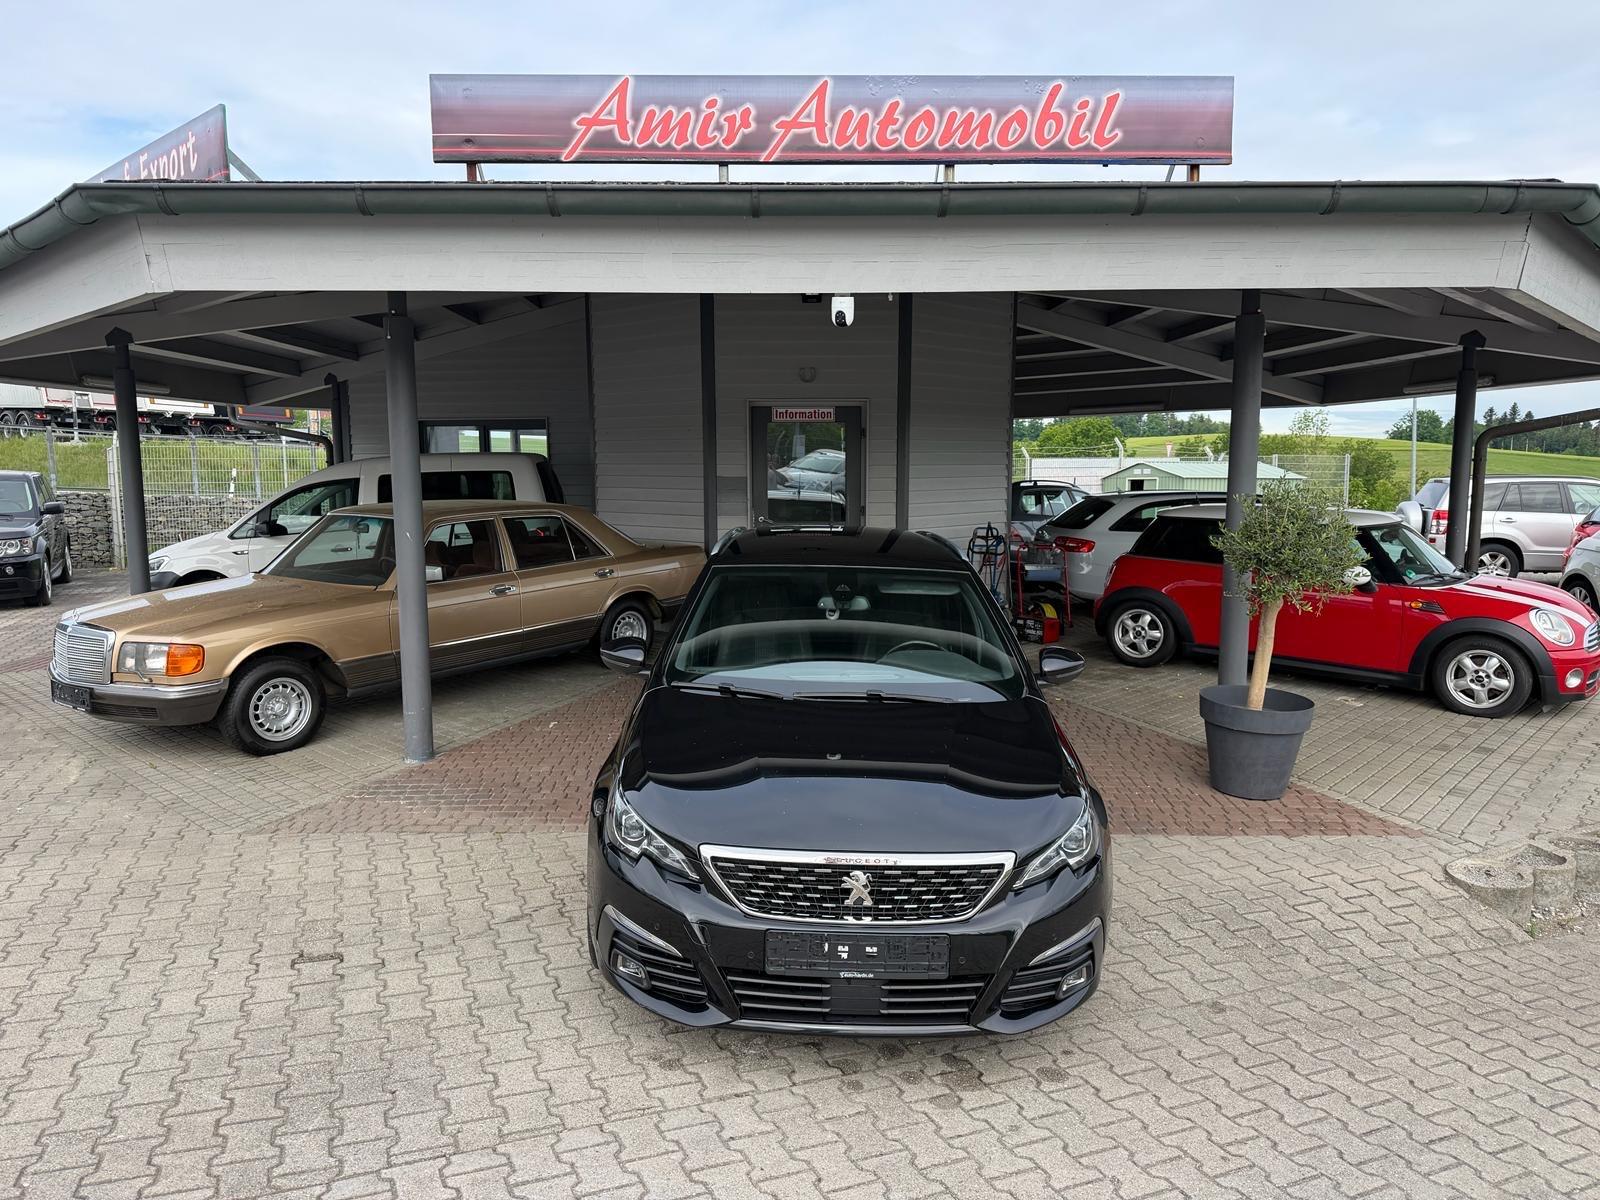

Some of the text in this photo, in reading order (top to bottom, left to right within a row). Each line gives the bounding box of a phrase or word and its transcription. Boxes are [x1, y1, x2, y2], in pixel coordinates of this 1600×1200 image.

[562, 76, 1123, 162] Amir Automobil
[774, 409, 833, 420] Information
